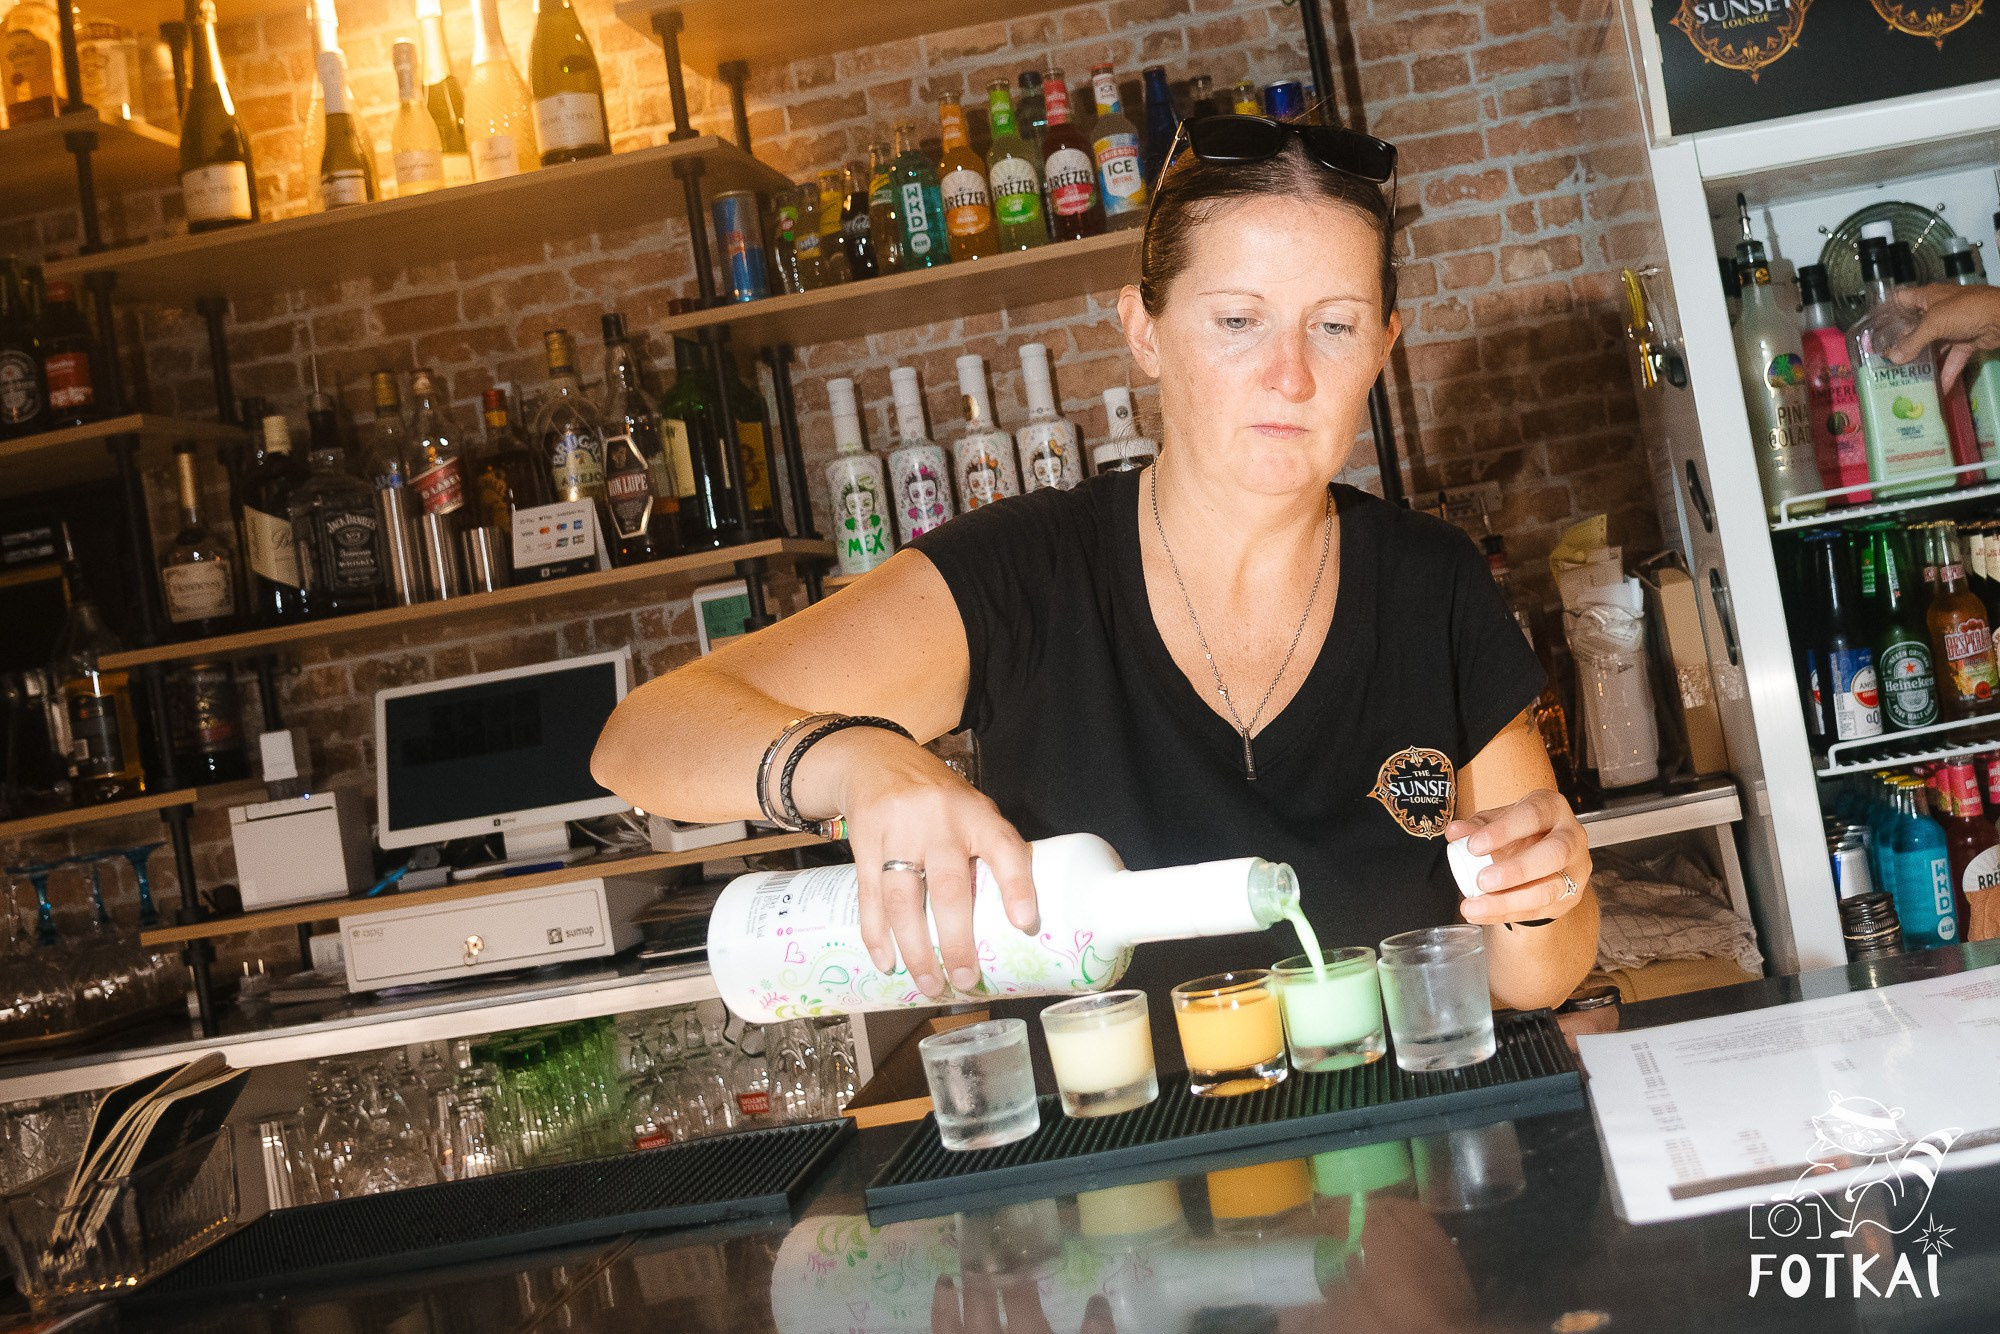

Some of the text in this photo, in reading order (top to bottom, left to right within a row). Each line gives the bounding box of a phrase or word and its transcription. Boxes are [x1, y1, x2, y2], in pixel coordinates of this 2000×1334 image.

[1721, 13, 1771, 29] LOUNGE
[1107, 160, 1133, 176] ICE
[906, 186, 923, 228] WKD
[1874, 363, 1932, 382] IMPERIO
[1811, 384, 1857, 400] IMPERI
[608, 473, 648, 496] RON LUPE
[847, 527, 886, 558] MEX
[1884, 675, 1935, 692] Heineken
[1412, 769, 1431, 777] THE
[1388, 779, 1452, 798] SUNSET
[1409, 796, 1440, 804] LOUNGE
[1935, 864, 1951, 911] WKD
[566, 925, 595, 939] sumup
